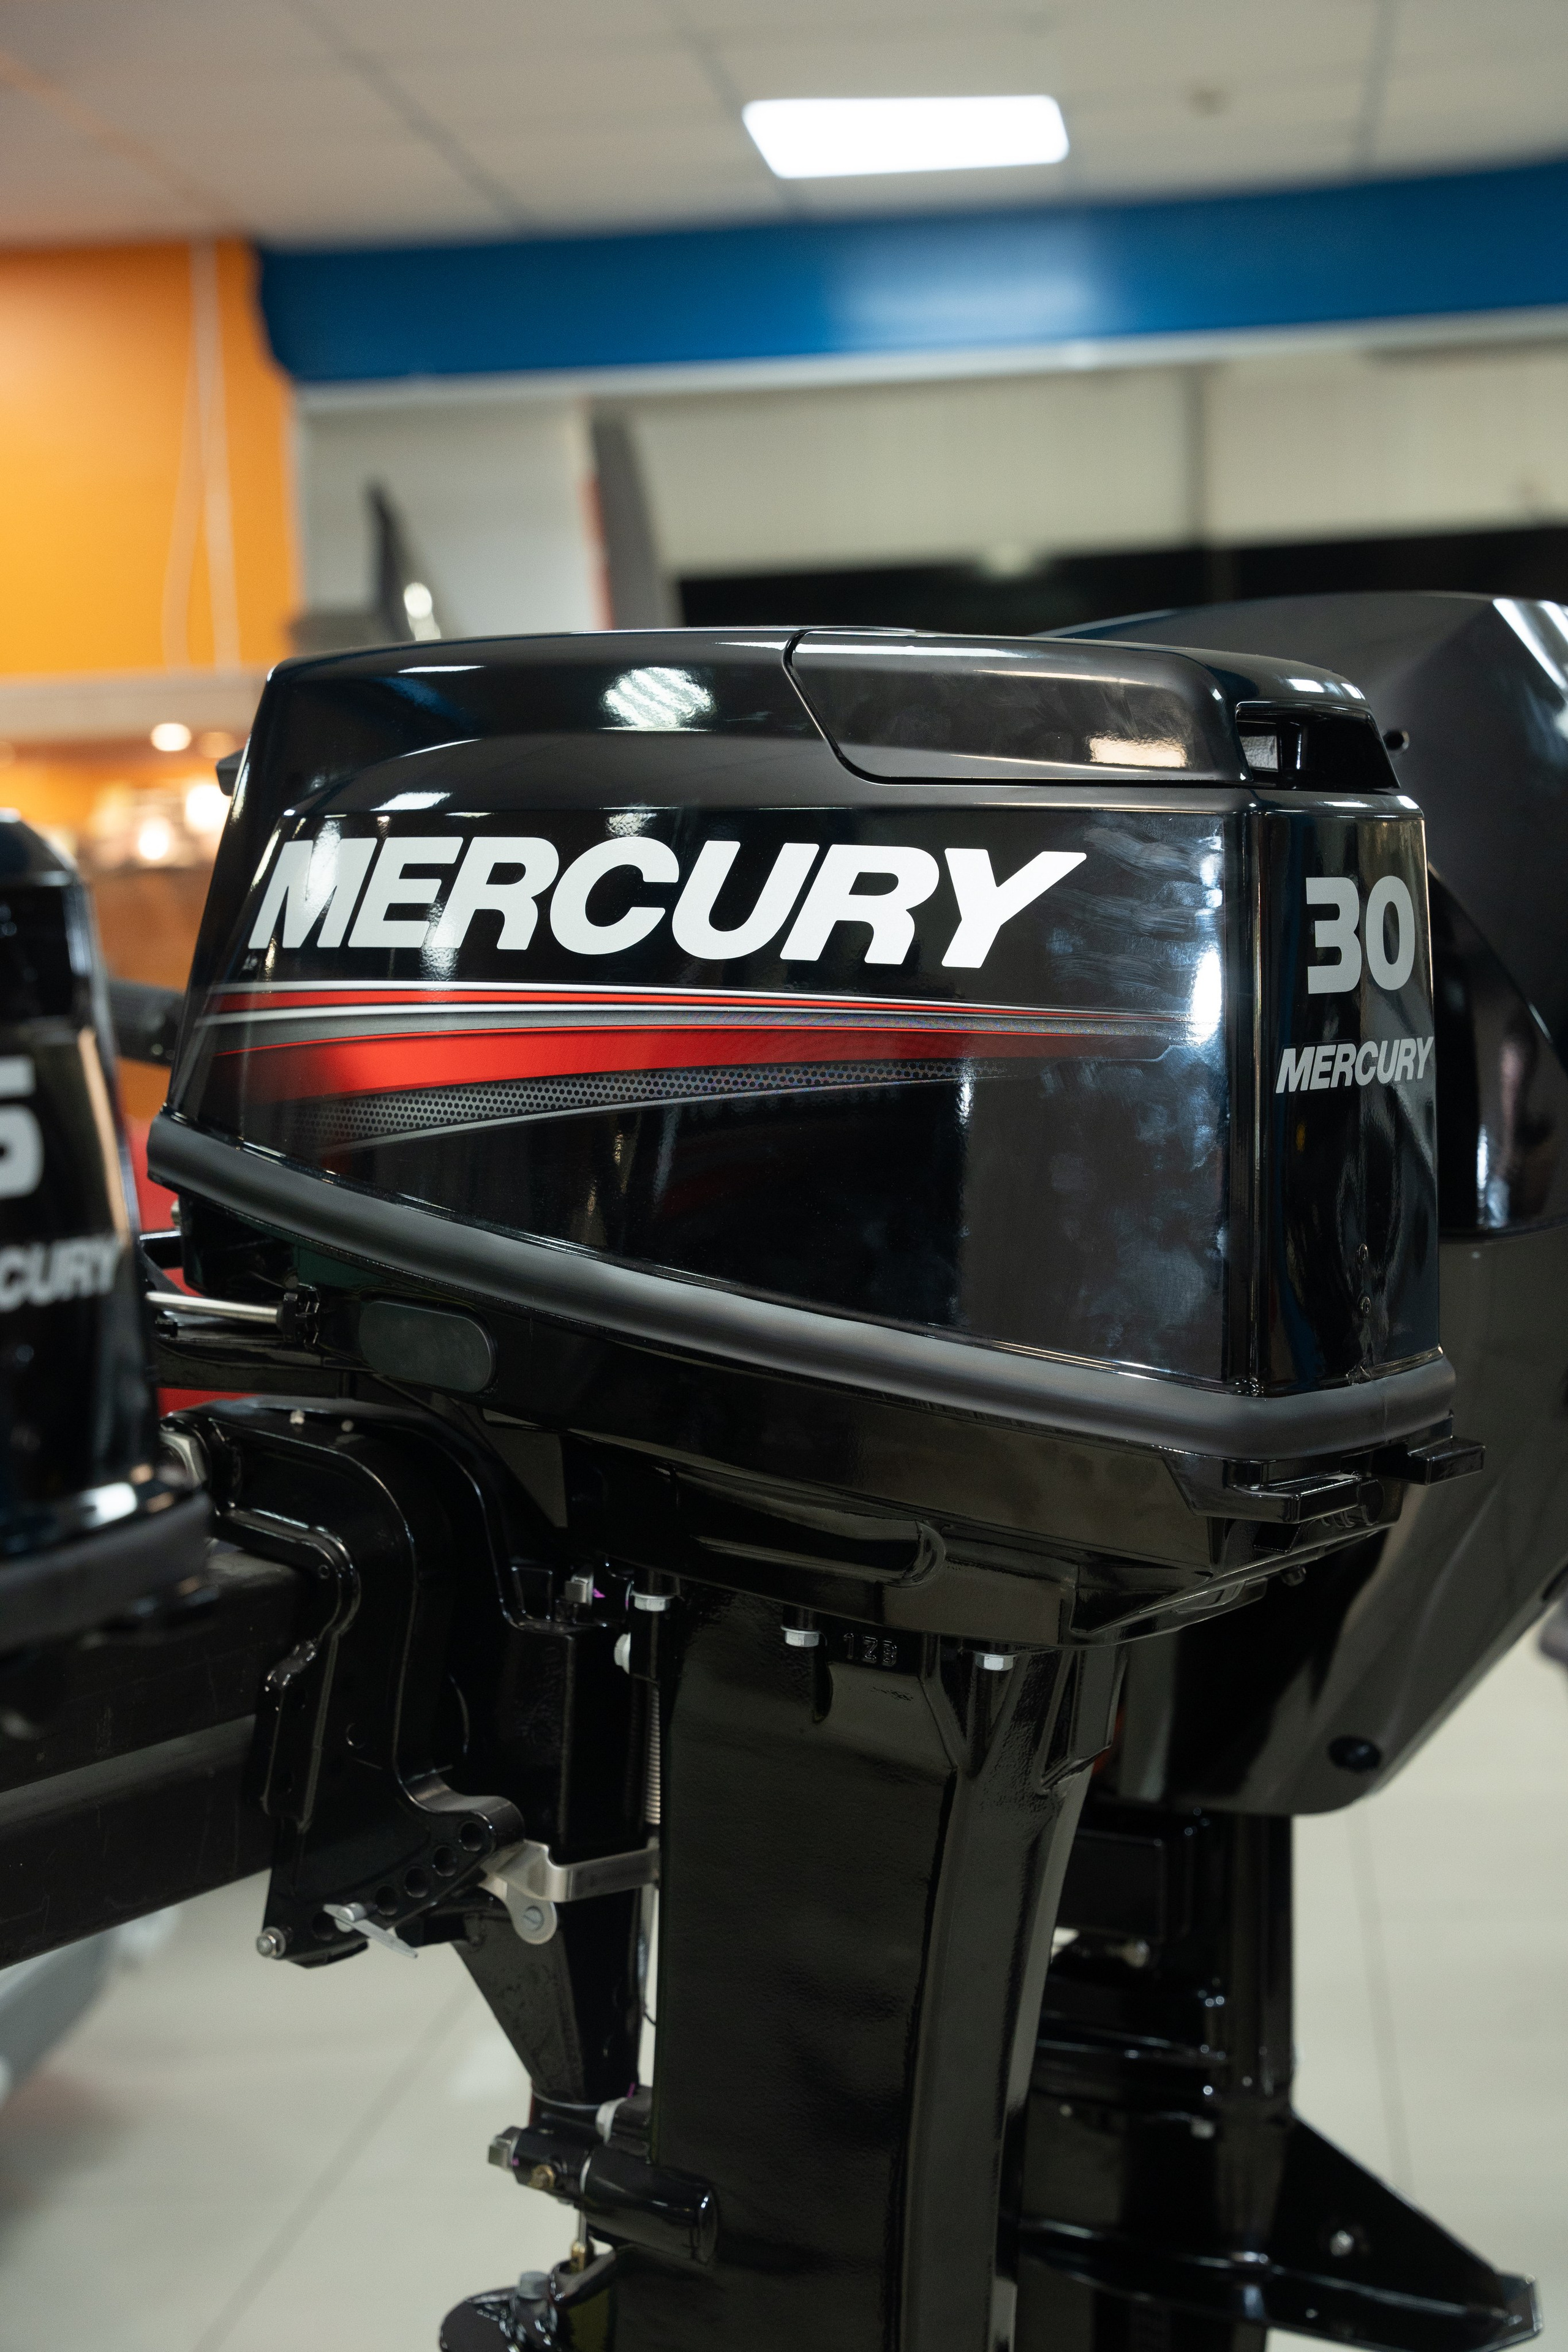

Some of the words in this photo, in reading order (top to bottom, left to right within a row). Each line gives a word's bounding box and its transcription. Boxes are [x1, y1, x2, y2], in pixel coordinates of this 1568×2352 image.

[248, 837, 1087, 968] MERCURY
[1306, 875, 1415, 994] 30
[1276, 1036, 1434, 1093] MERCURY
